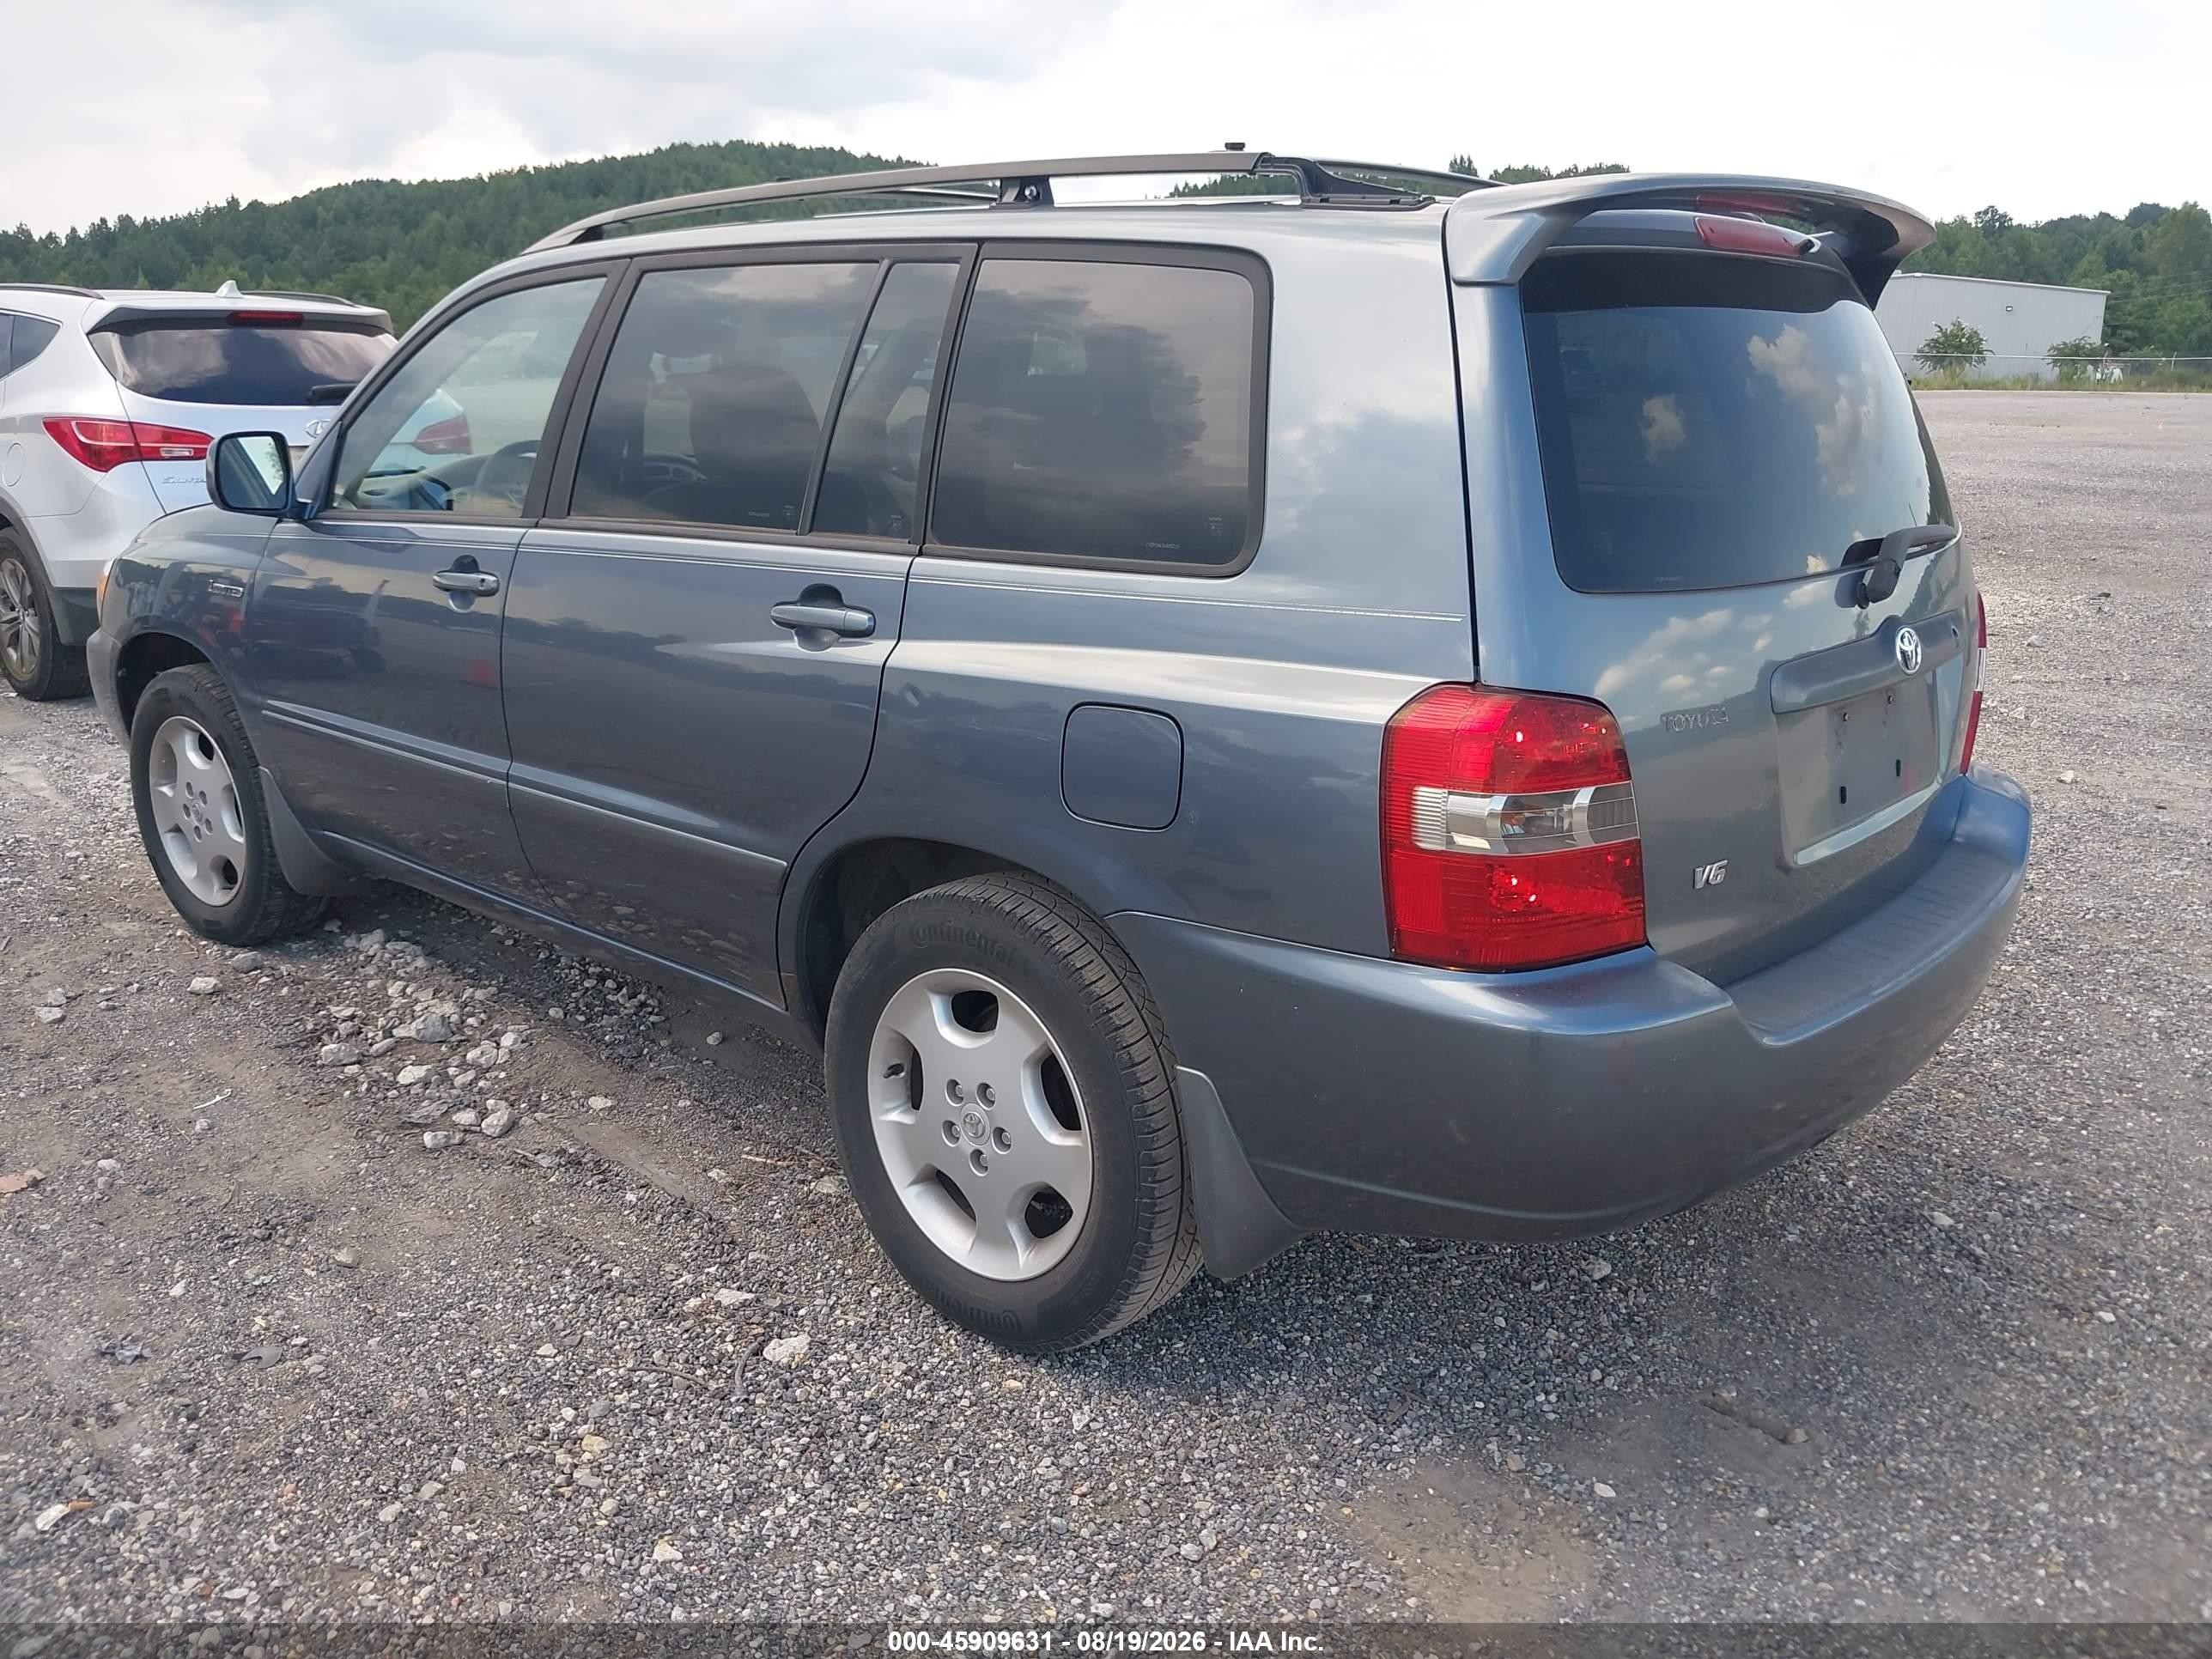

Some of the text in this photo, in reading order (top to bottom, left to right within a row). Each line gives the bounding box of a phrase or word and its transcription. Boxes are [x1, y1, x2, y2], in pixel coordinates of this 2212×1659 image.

[1661, 707, 1729, 732] TOYOTA
[1692, 859, 1729, 890] V6
[912, 919, 1017, 964] Continental
